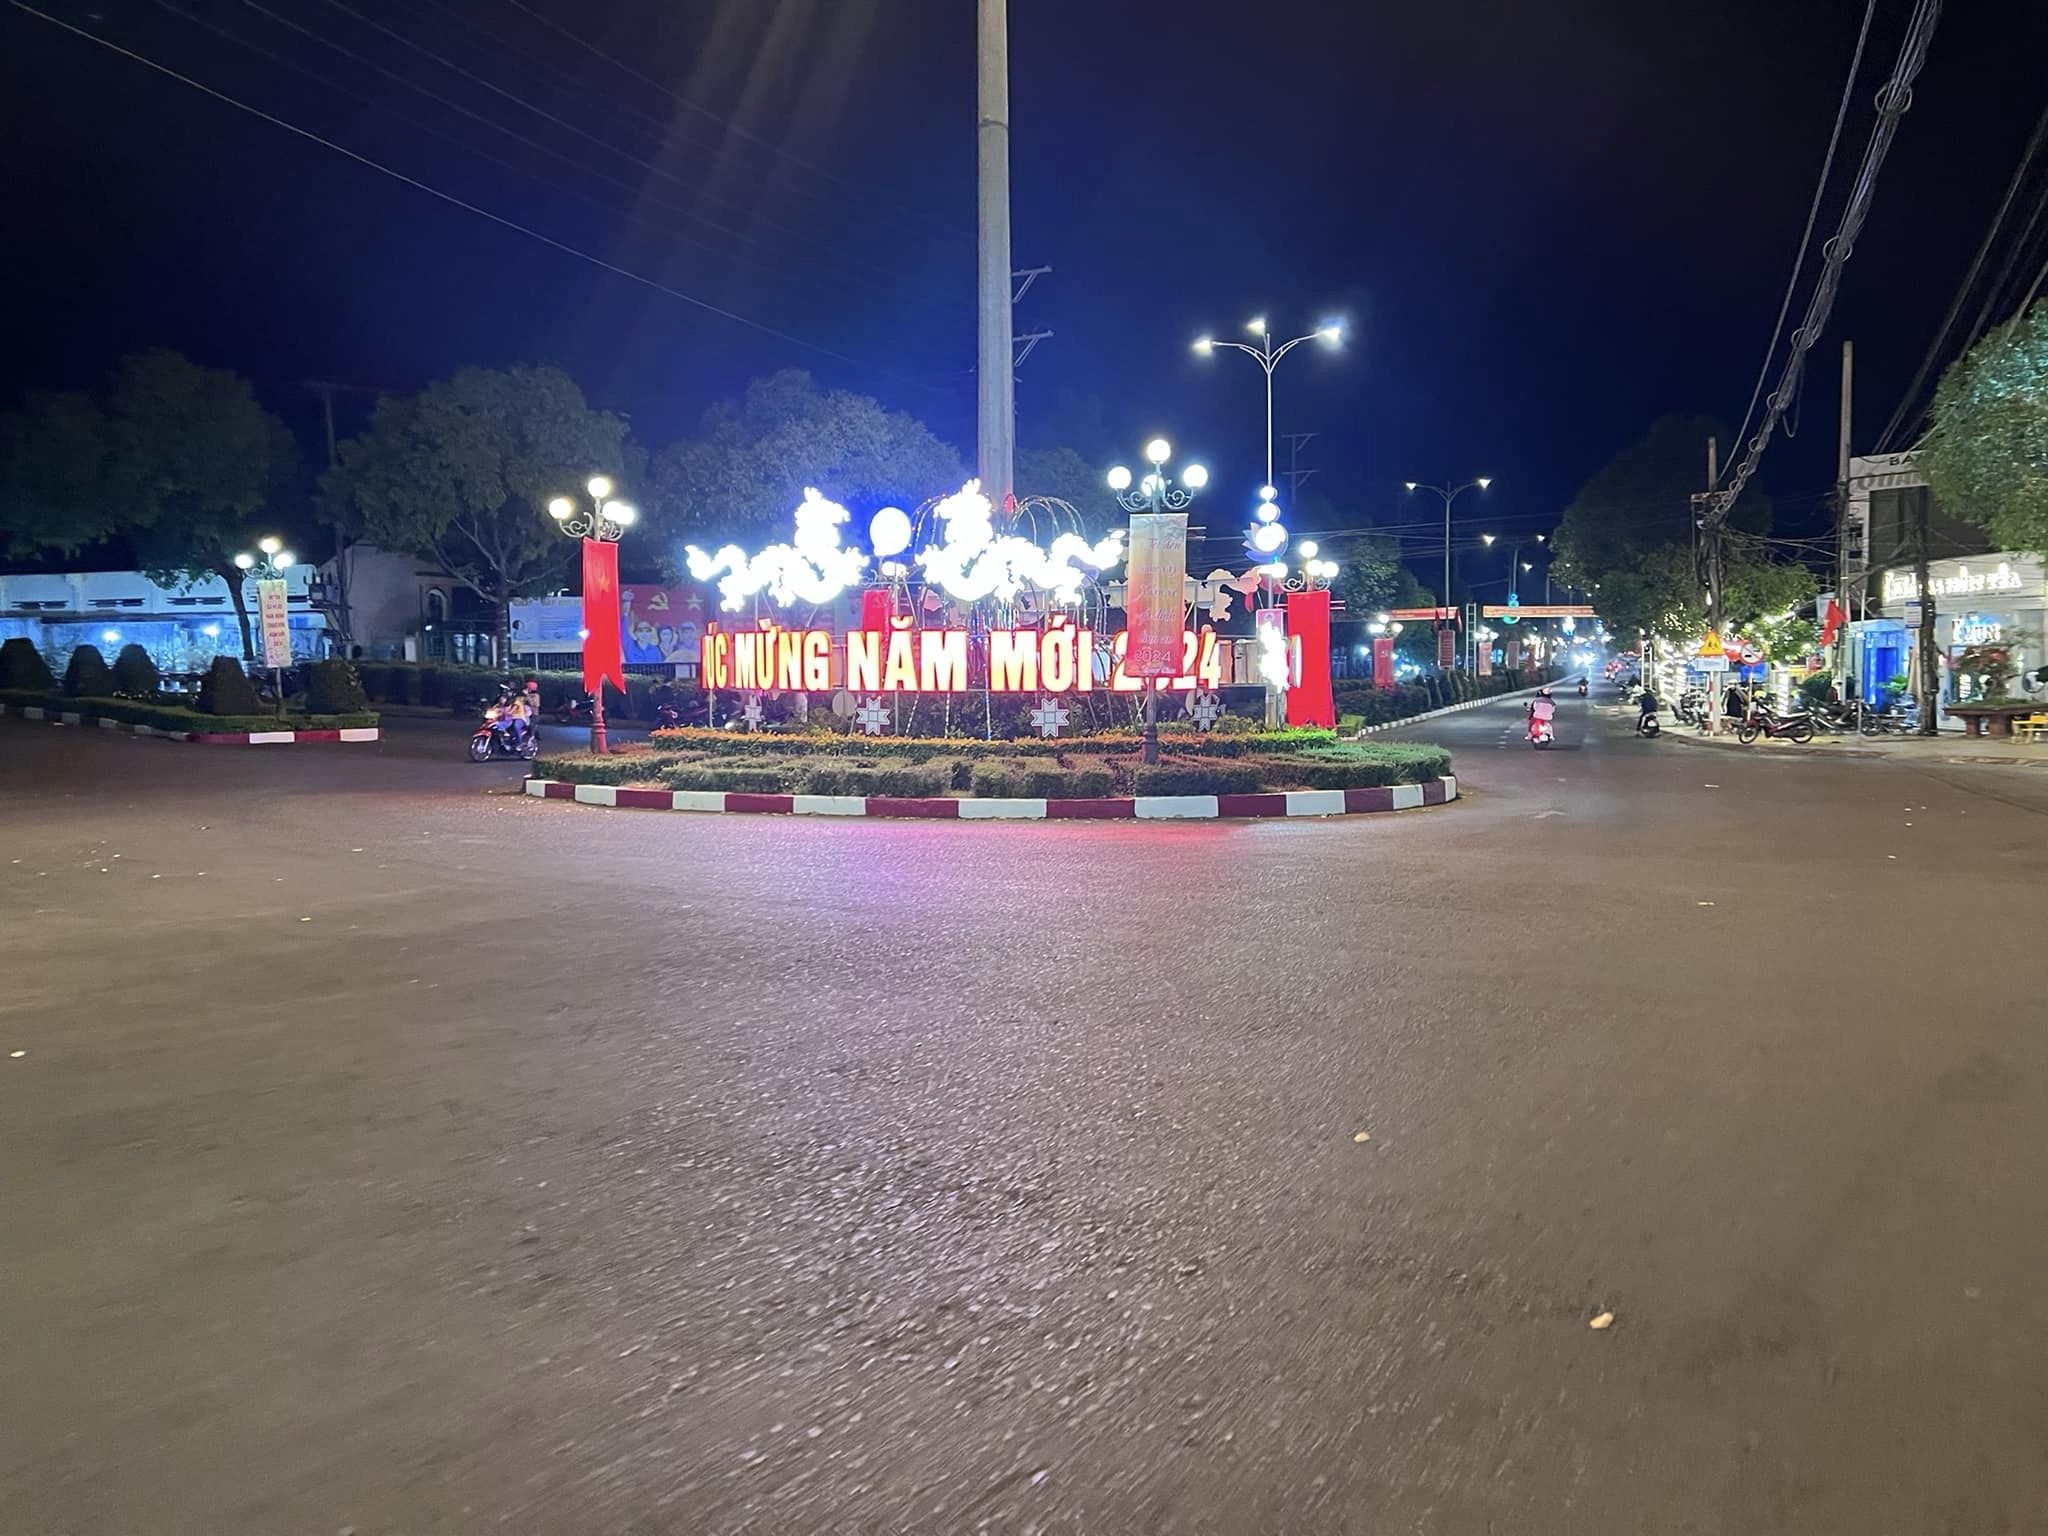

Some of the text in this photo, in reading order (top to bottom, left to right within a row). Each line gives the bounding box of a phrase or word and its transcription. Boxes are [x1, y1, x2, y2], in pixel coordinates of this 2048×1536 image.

[734, 617, 832, 692] MỪNG
[847, 614, 968, 692] NĂM
[989, 611, 1094, 693] MỚI
[1112, 628, 1221, 692] 224
[1134, 649, 1171, 662] 2024
